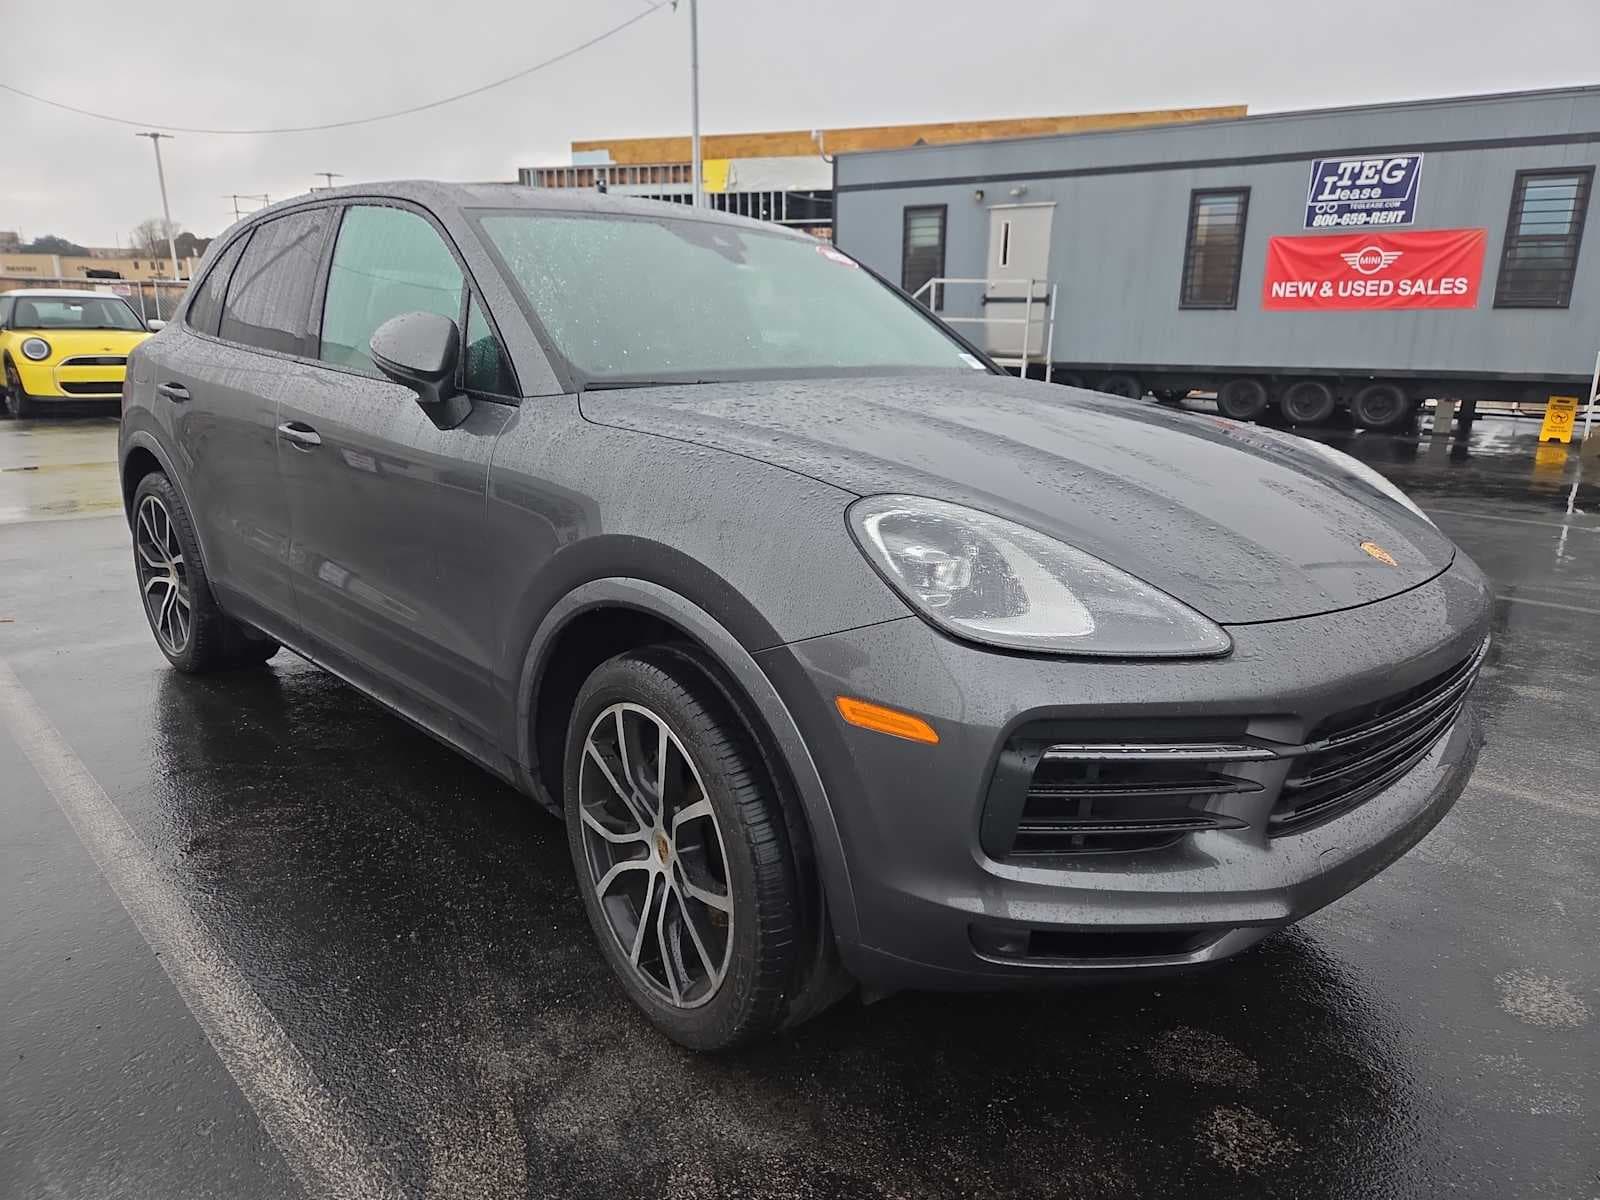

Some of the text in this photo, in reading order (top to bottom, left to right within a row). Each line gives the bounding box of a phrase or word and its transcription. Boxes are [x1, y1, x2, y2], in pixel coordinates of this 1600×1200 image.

[1337, 159, 1408, 186] TEG
[1318, 176, 1381, 200] Lease
[1313, 211, 1405, 226] 800-659-RENT
[1360, 256, 1381, 264] MINI
[1272, 278, 1468, 297] NEW & USED SALES
